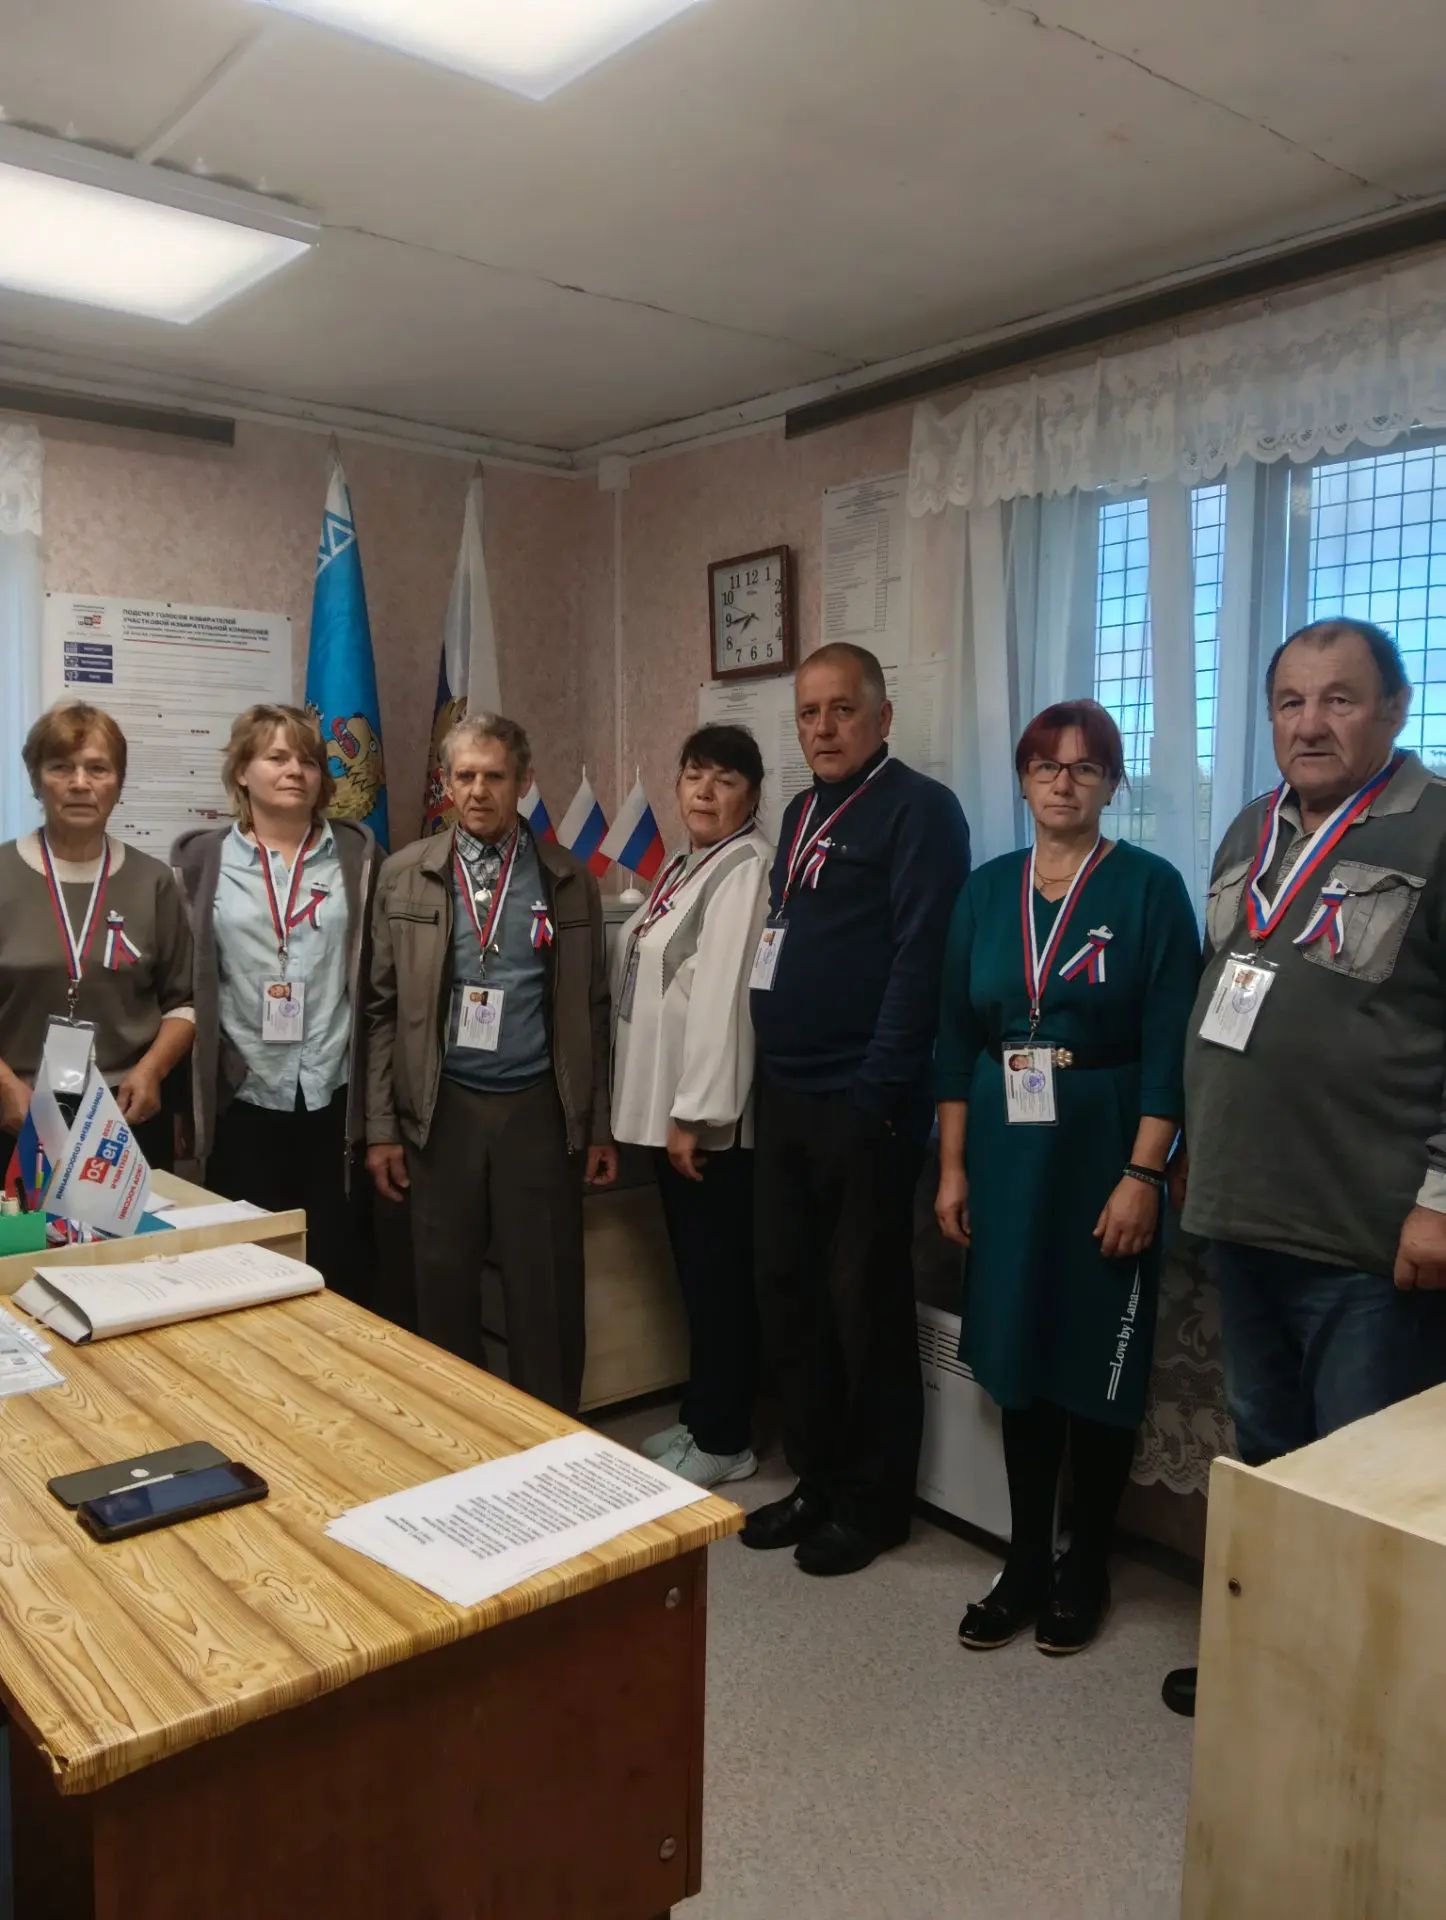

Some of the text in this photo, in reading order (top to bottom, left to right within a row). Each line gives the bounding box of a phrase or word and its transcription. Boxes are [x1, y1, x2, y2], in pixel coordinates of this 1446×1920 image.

[730, 567, 771, 589] 11 12 1
[722, 590, 734, 605] 10
[774, 578, 782, 594] 2
[725, 603, 783, 628] 9 3
[726, 627, 783, 651] 8 4
[736, 644, 773, 663] 7 6 5
[1110, 1294, 1139, 1369] Love by Lana
